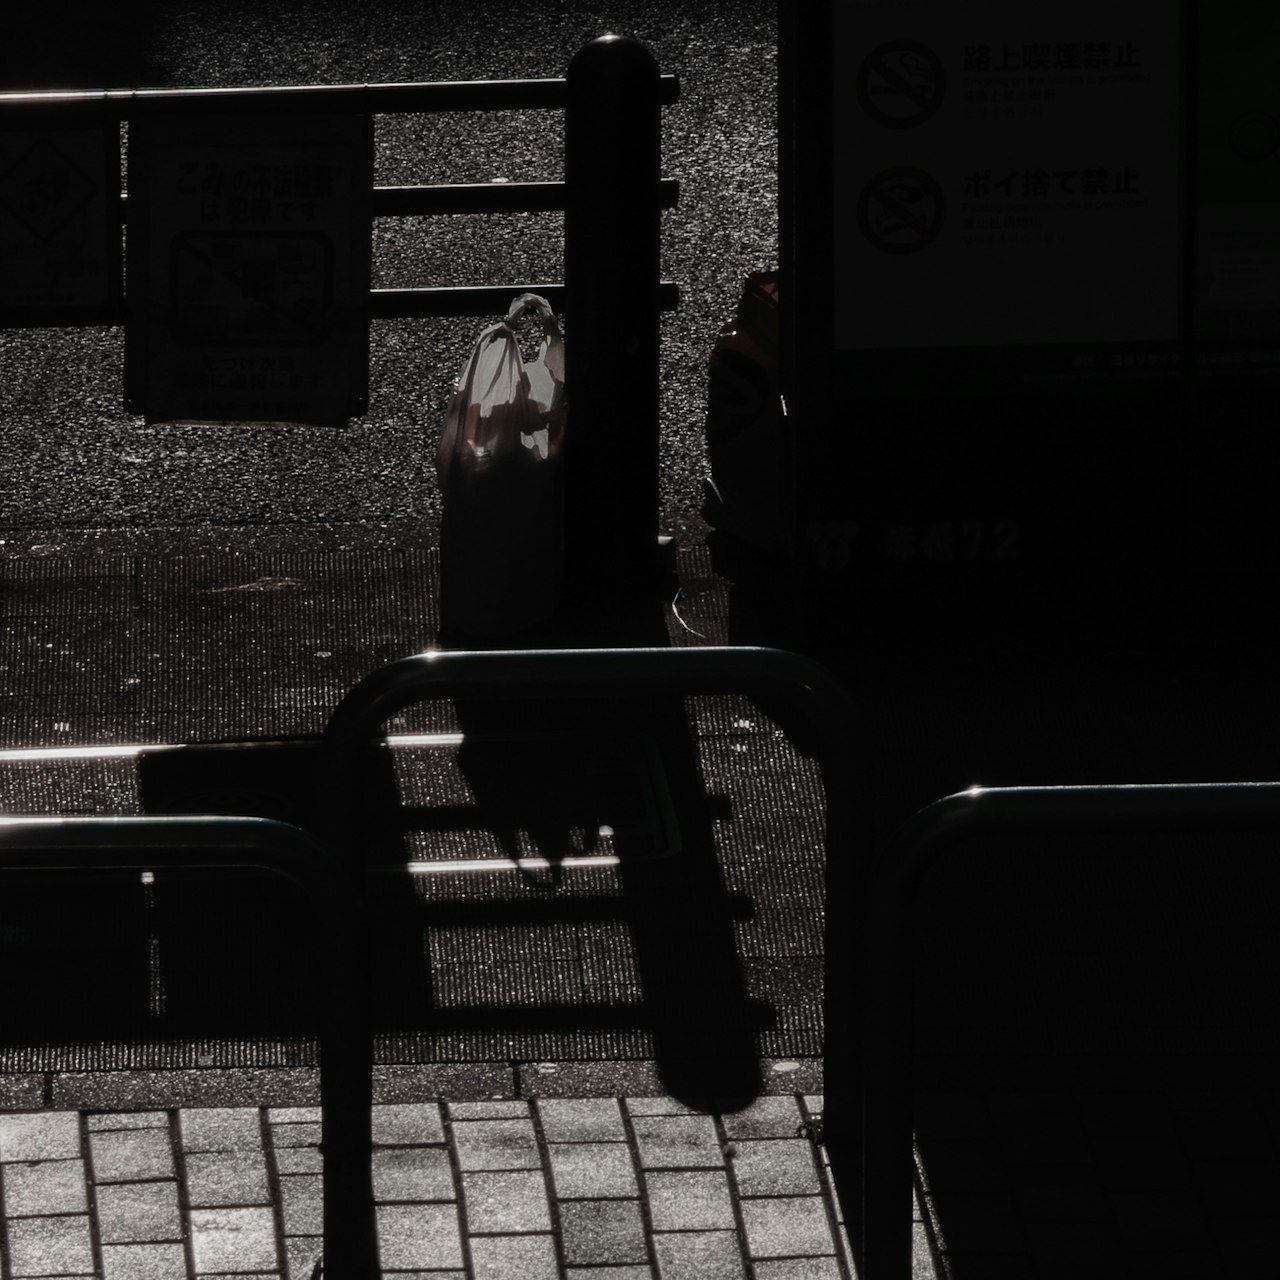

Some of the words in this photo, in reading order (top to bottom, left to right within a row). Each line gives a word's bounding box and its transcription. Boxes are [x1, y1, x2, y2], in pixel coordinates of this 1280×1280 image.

[961, 39, 1143, 72] 路上喫煙禁止
[962, 166, 1140, 198] ポイ捨て禁止
